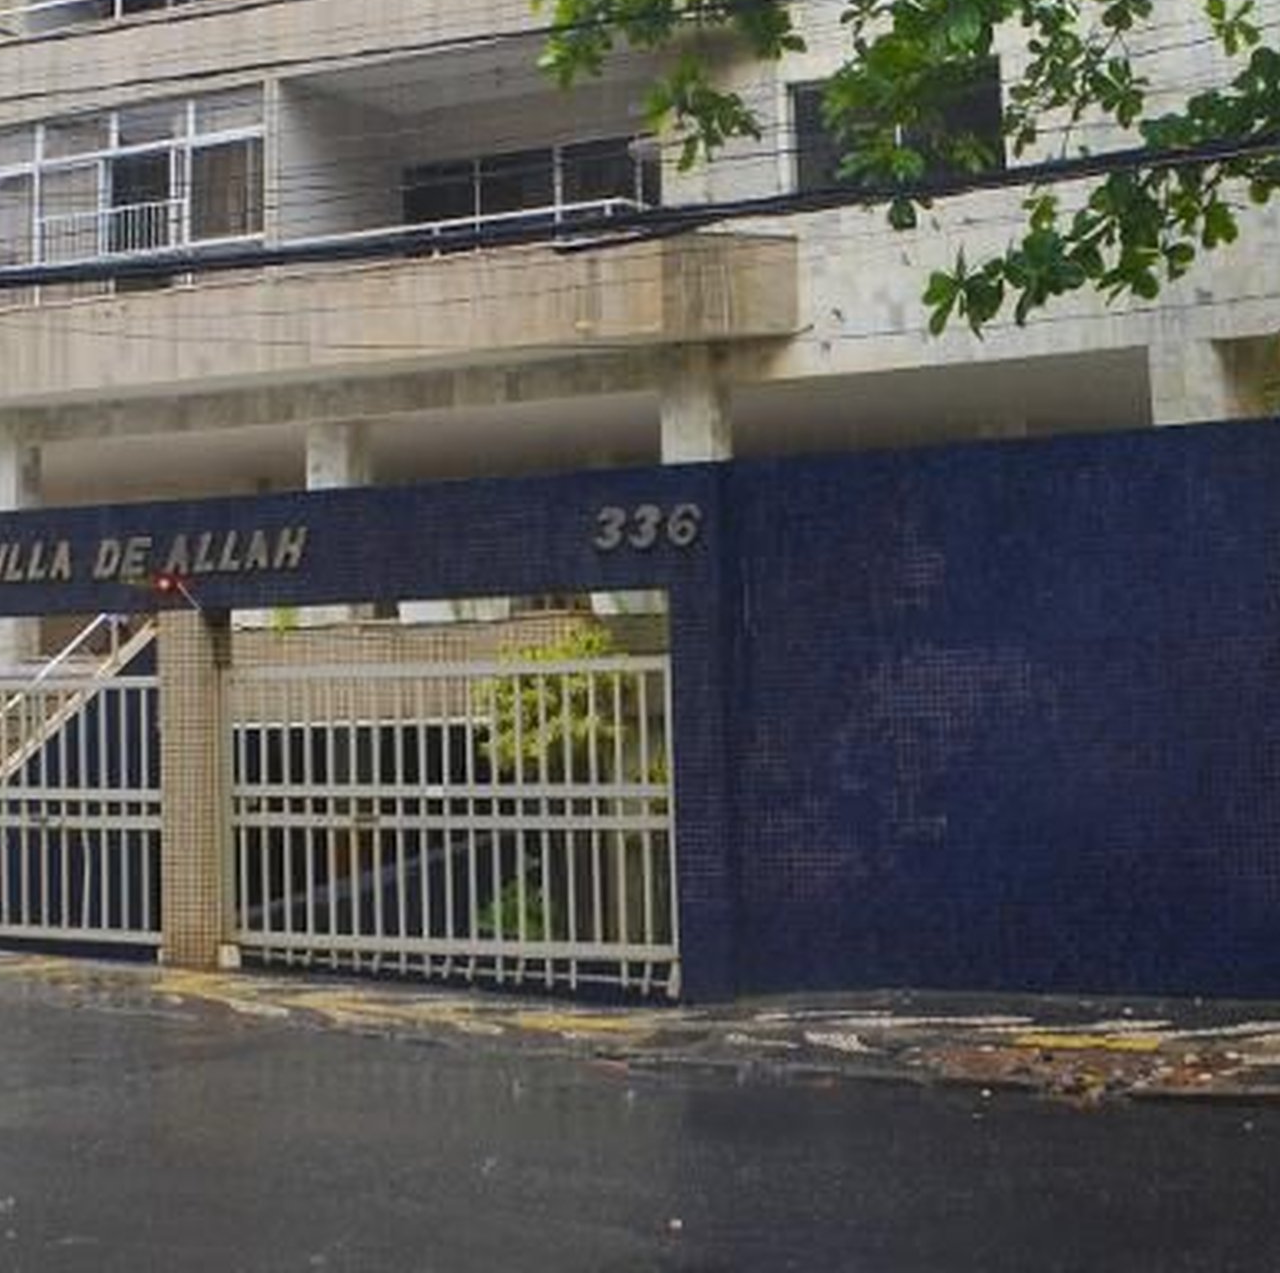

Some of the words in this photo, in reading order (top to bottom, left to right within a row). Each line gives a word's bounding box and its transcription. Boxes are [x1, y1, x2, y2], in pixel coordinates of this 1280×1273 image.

[595, 503, 703, 549] 336
[92, 535, 153, 579] DE
[166, 526, 308, 576] ALLAH
